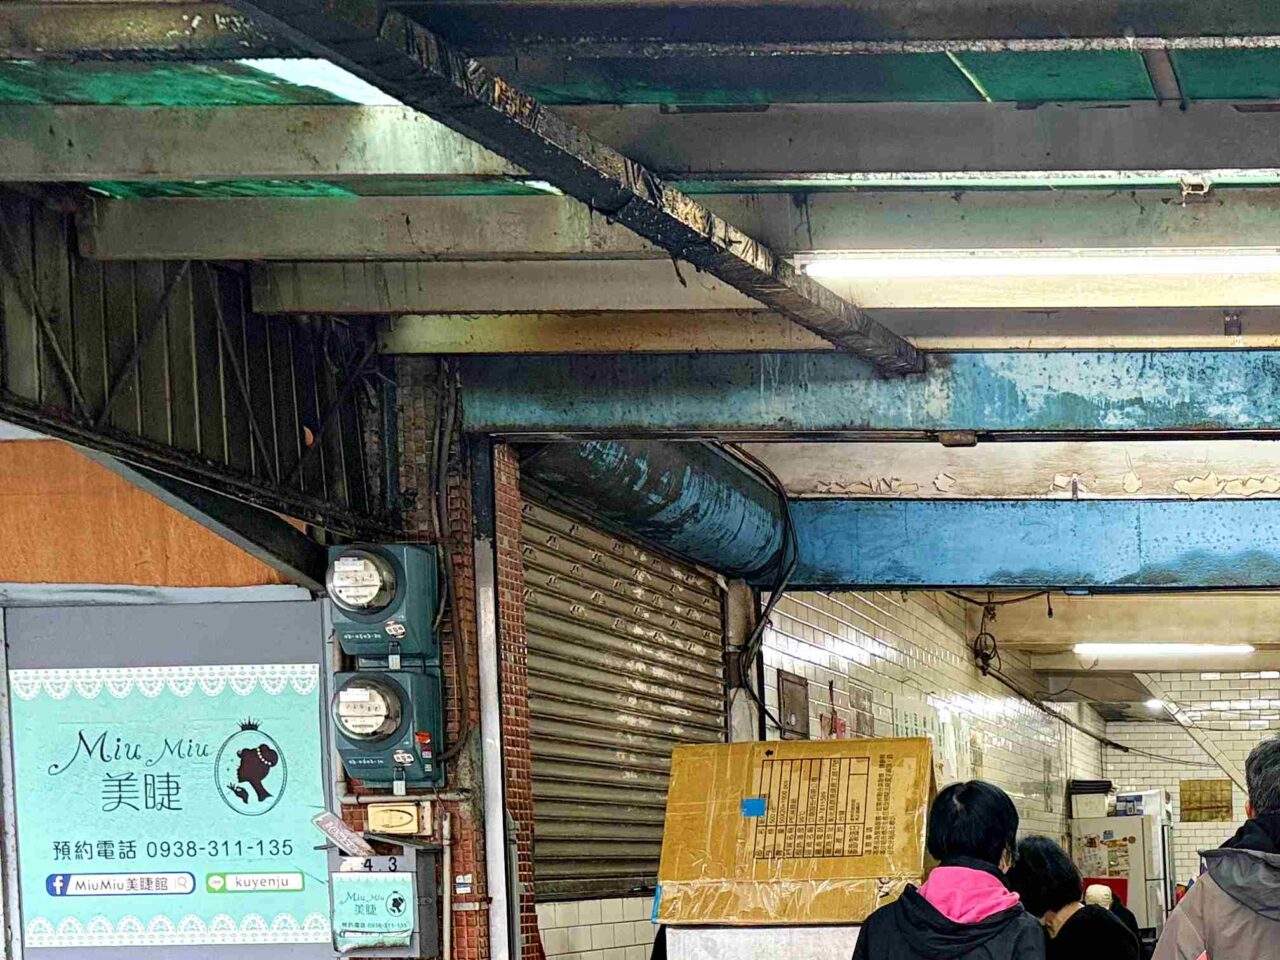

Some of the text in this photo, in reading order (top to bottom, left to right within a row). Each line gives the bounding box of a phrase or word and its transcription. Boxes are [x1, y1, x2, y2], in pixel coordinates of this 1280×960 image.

[48, 728, 210, 776] Miu Miu
[101, 771, 183, 812] 美睫
[52, 839, 294, 861] 預約電話 0938-311-135
[75, 877, 169, 892] MiuMiu美睫館
[235, 877, 289, 889] kuyenju
